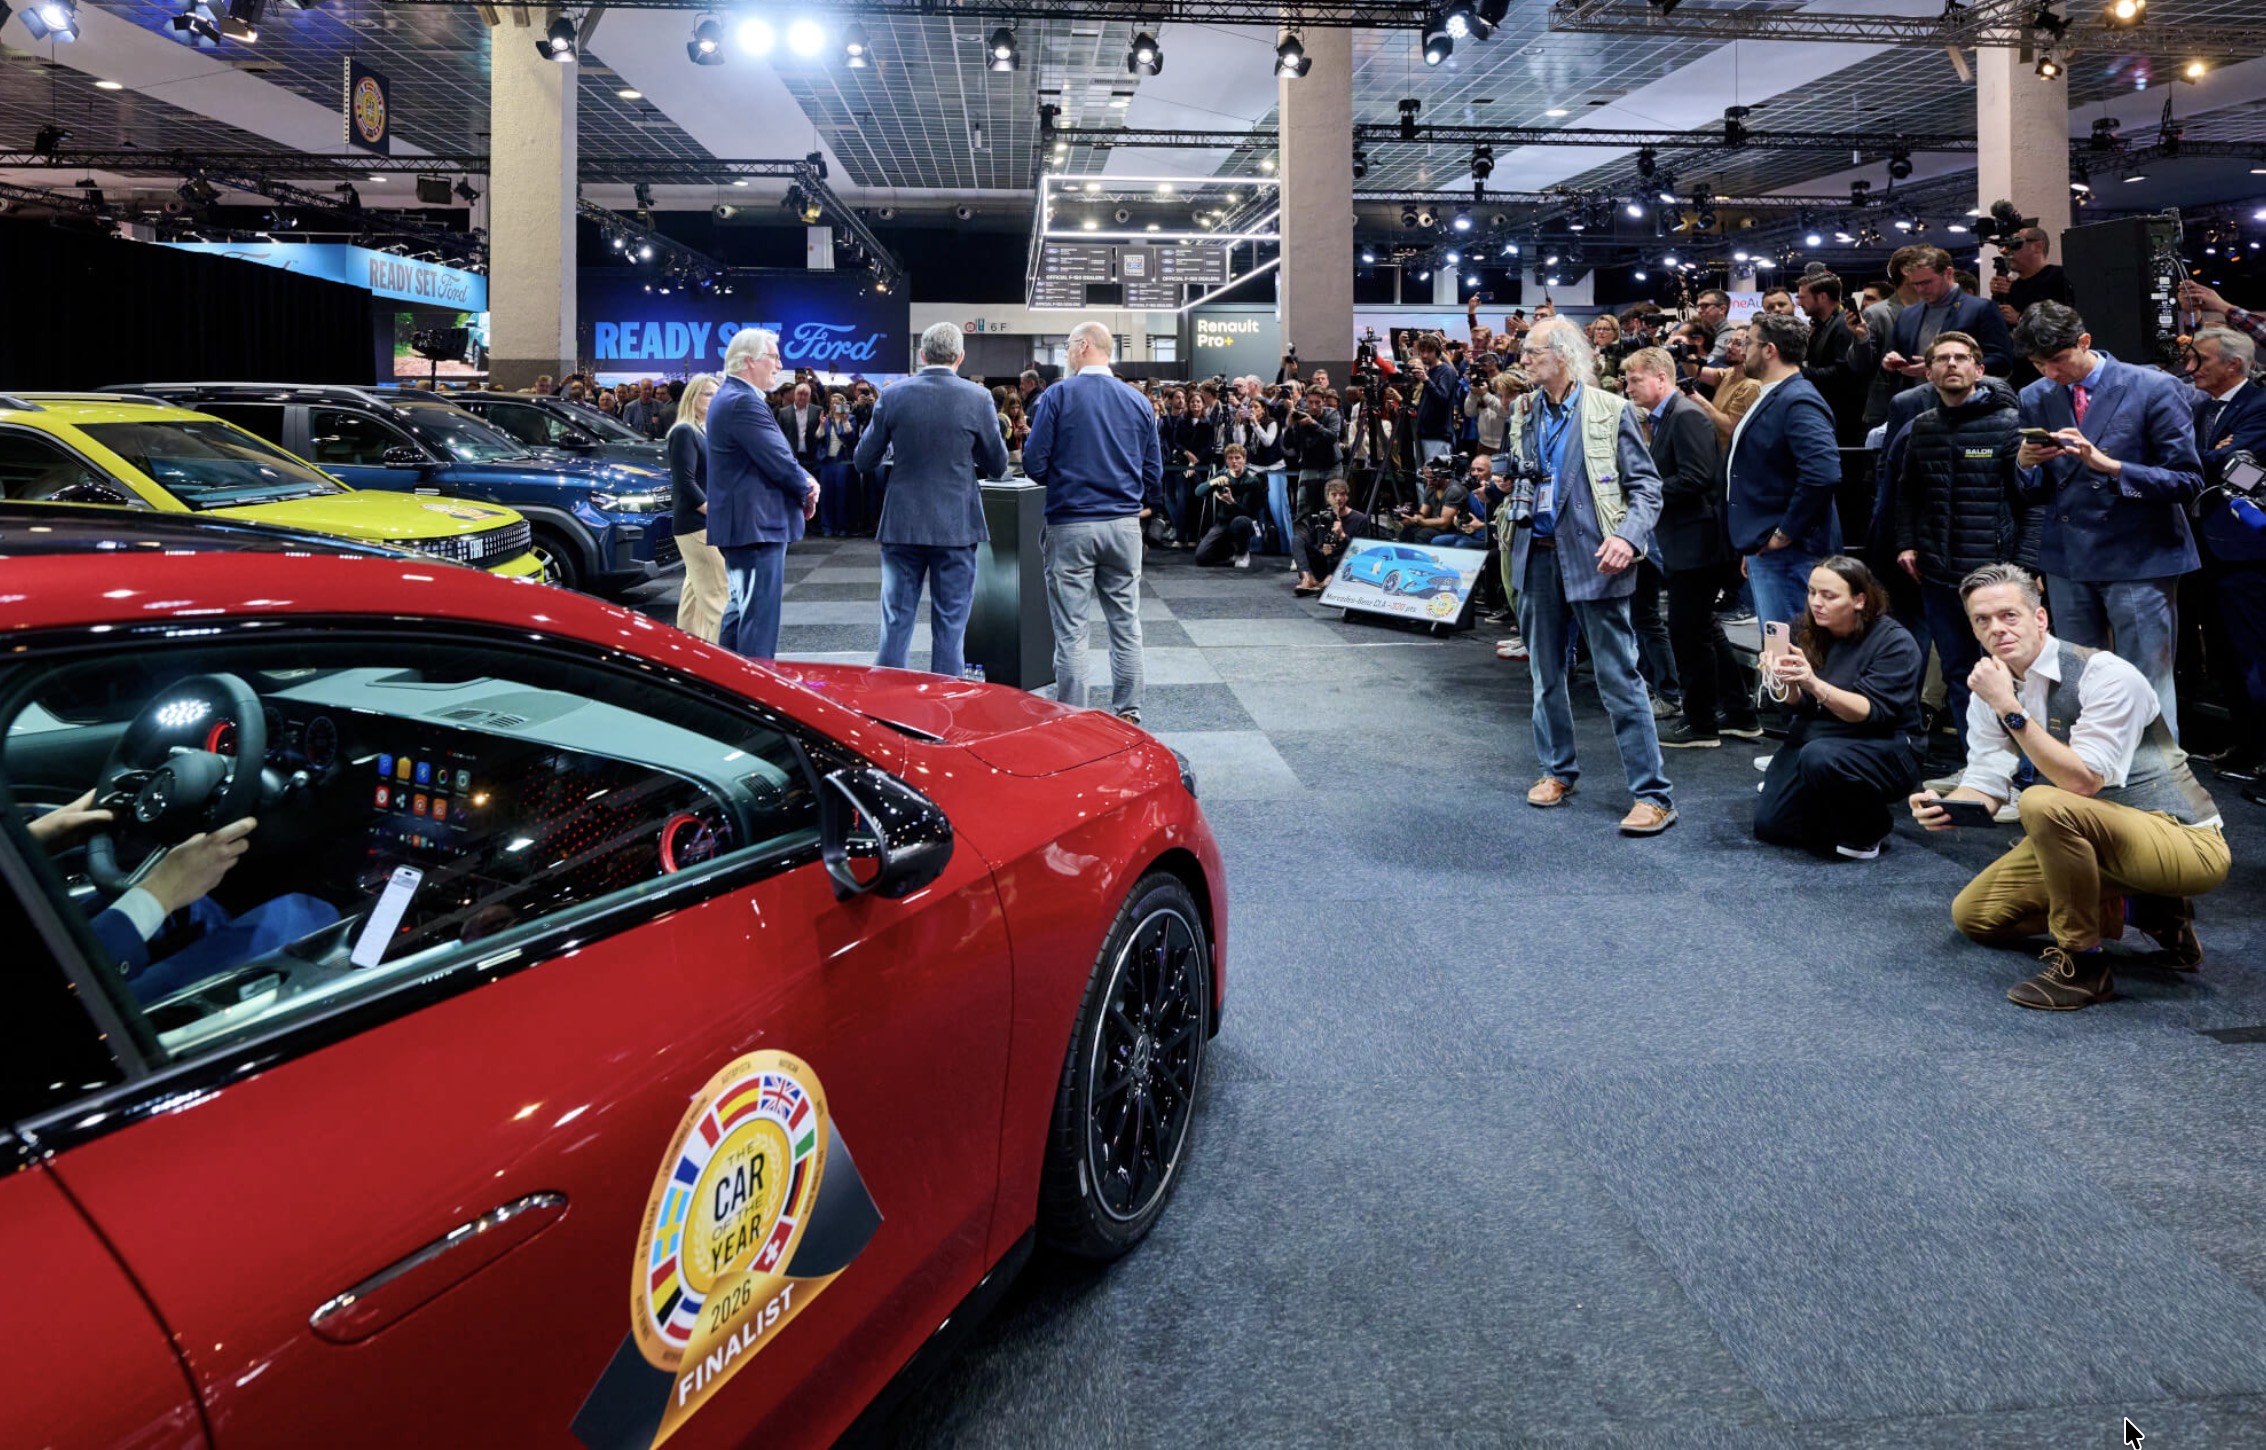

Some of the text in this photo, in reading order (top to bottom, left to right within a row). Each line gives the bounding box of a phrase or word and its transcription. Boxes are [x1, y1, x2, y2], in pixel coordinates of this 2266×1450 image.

[369, 257, 468, 302] READY SET Ford
[595, 321, 712, 359] READY
[784, 322, 879, 361] Ford
[990, 322, 1008, 332] 6 F
[1197, 318, 1260, 333] Renault
[1197, 334, 1234, 348] Pro+
[469, 538, 484, 560] FIAT
[1373, 599, 1387, 608] CLA
[727, 1140, 754, 1167] THE
[714, 1151, 765, 1222] CAR
[711, 1194, 764, 1242] OF THE
[711, 1213, 762, 1274] YEAR
[711, 1278, 752, 1334] 2026
[678, 1281, 795, 1408] FINALIST
